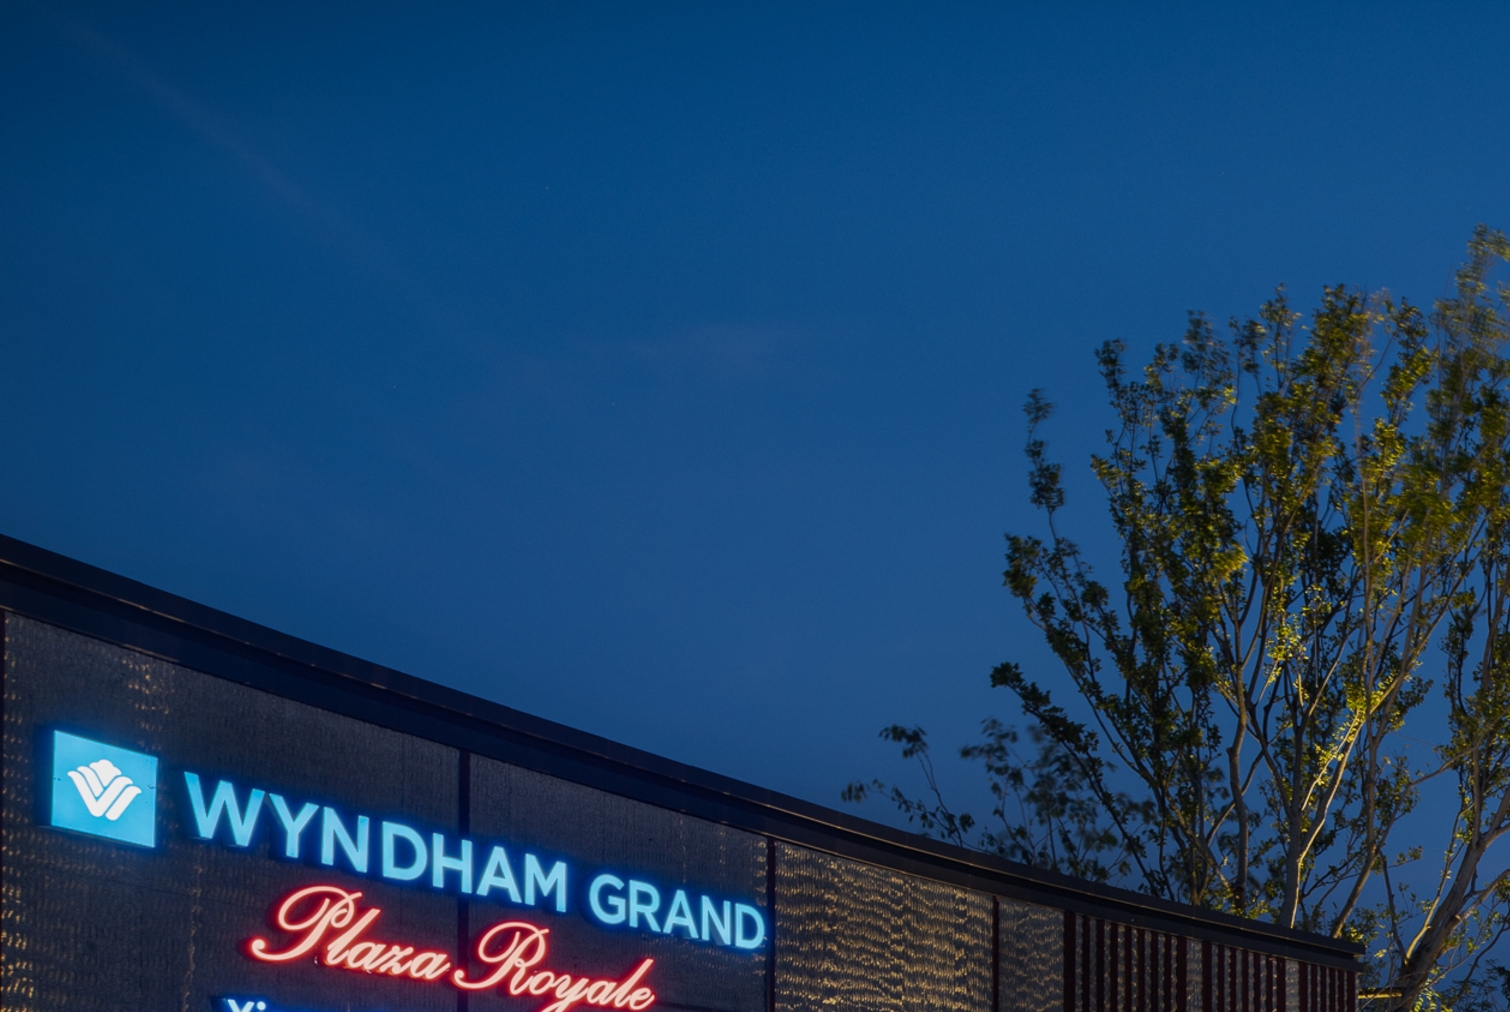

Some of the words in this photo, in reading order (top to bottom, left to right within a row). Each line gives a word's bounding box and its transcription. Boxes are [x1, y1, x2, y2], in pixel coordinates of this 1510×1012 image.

[183, 771, 568, 912] WYNDHAM
[589, 874, 766, 950] GRAND
[250, 886, 451, 982] Plaza
